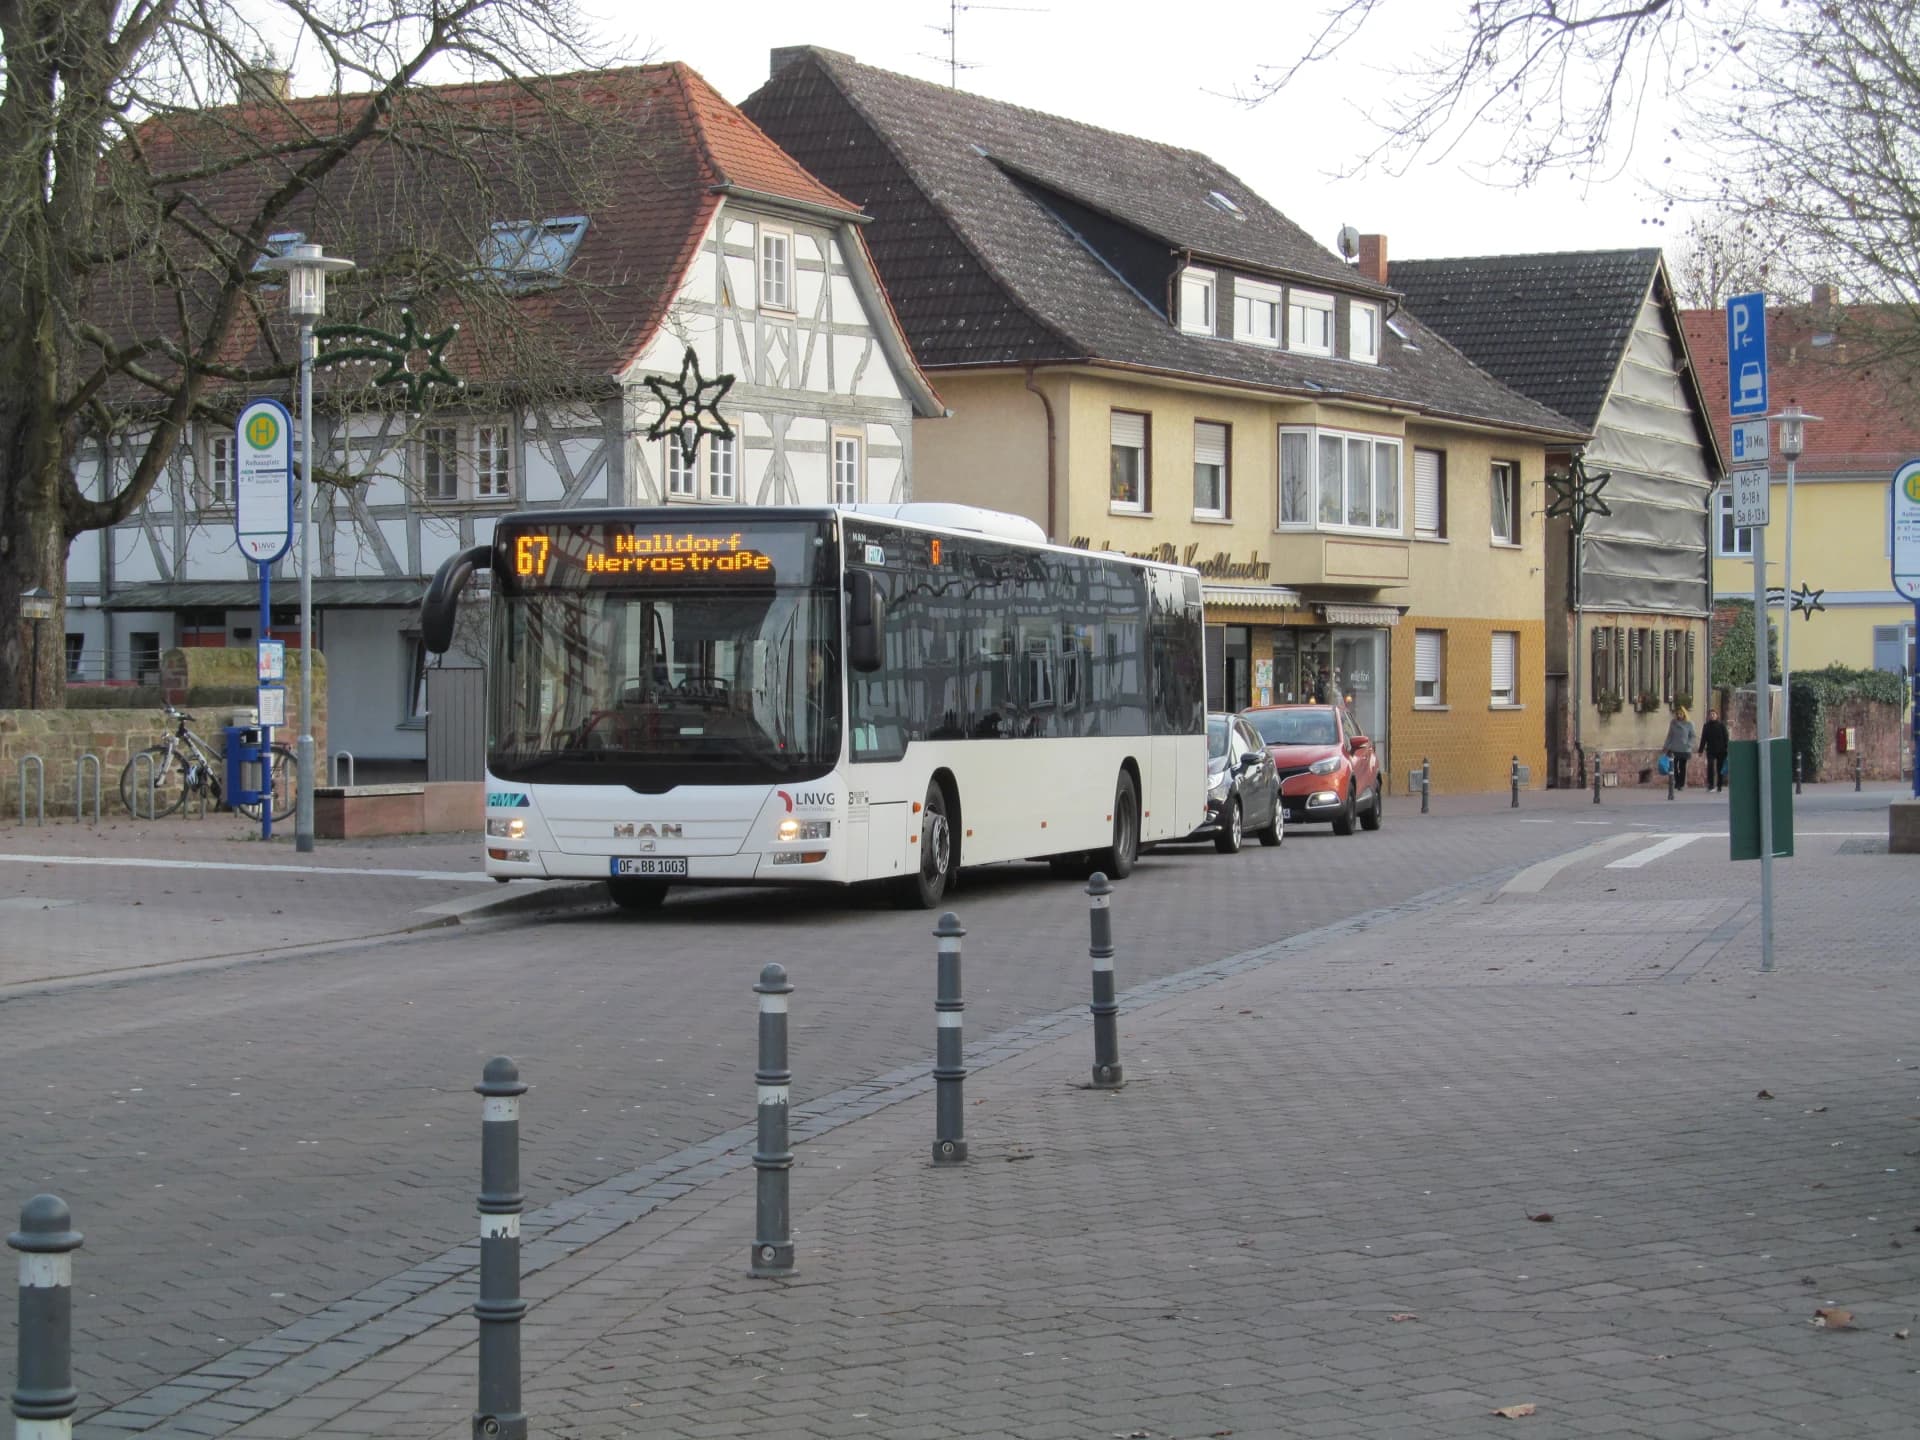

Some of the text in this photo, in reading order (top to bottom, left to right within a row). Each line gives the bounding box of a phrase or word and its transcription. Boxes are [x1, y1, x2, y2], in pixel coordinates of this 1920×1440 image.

[1733, 304, 1749, 350] P
[256, 421, 269, 442] H
[1741, 473, 1760, 488] Mo-Fr
[616, 533, 741, 553] Walldorf
[516, 536, 549, 575] 67
[586, 552, 772, 573] Werrastraße
[796, 792, 835, 805] LNVG
[613, 823, 682, 838] MAN
[619, 859, 685, 873] OF BB 1003
